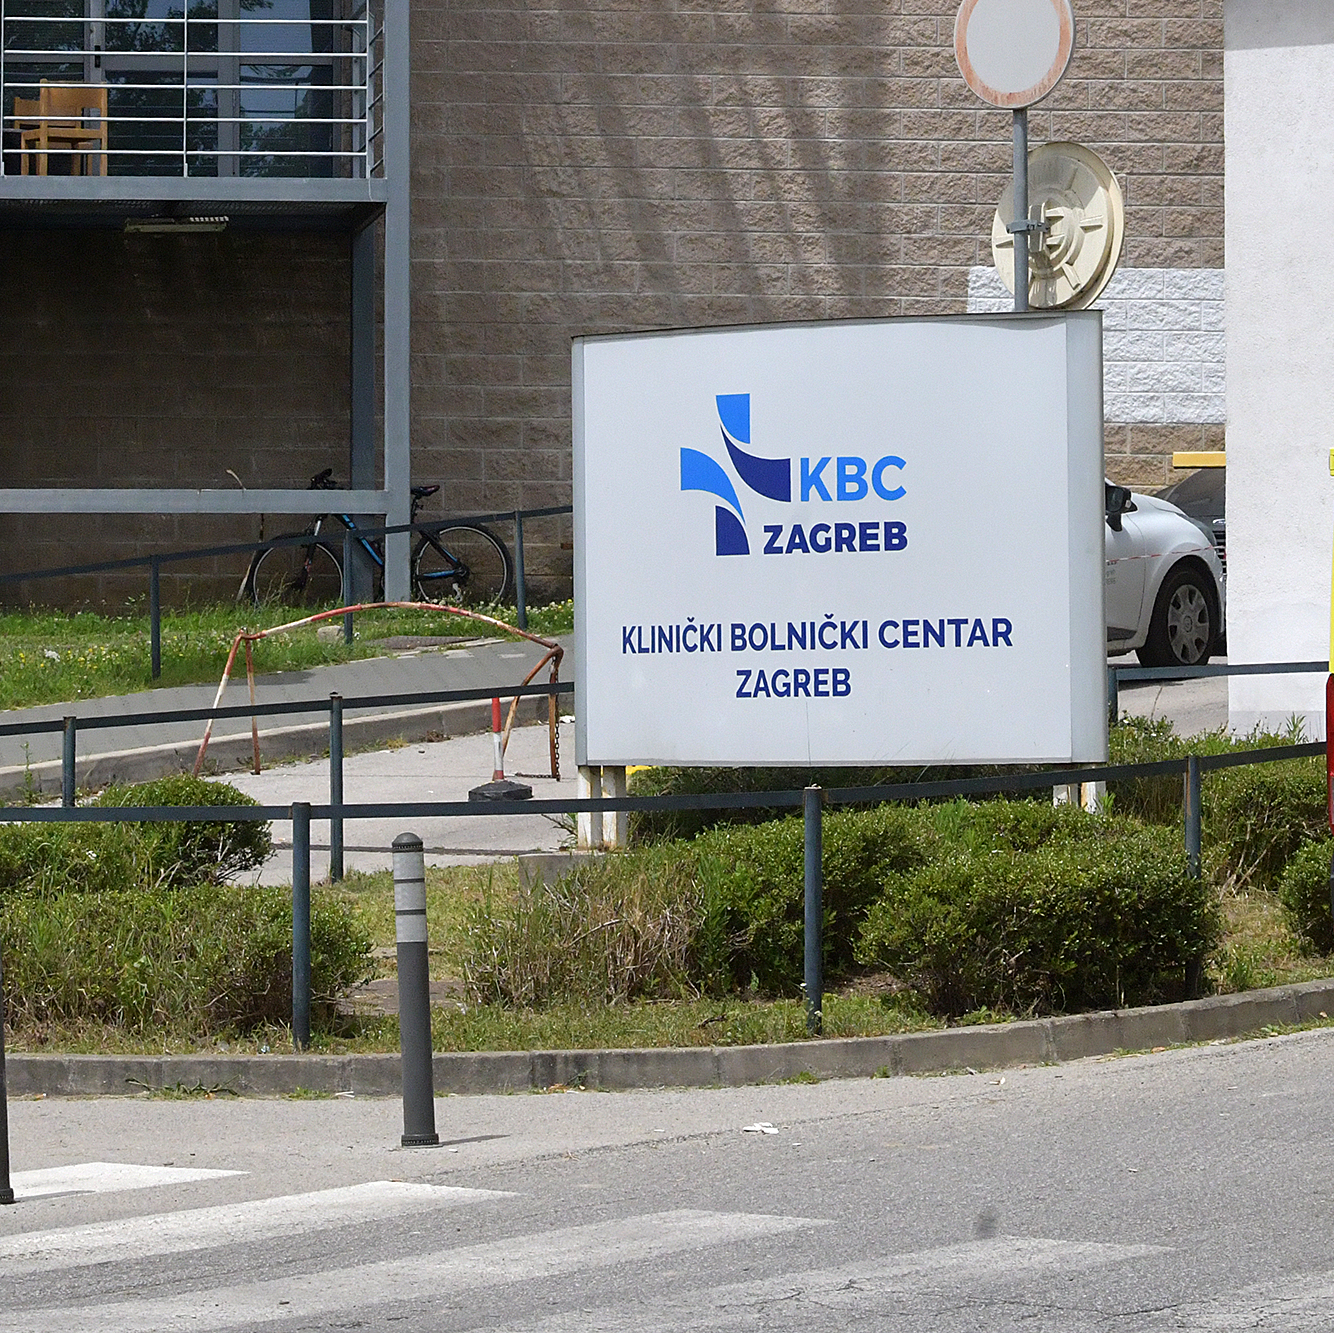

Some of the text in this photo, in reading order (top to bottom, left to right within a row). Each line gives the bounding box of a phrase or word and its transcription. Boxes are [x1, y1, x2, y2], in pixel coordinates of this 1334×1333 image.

[799, 455, 907, 503] KBC
[763, 521, 908, 555] ZAGREB
[622, 614, 1013, 654] KLINIČKI BOLNIČKI CENTAR
[736, 668, 851, 699] ZAGREB
